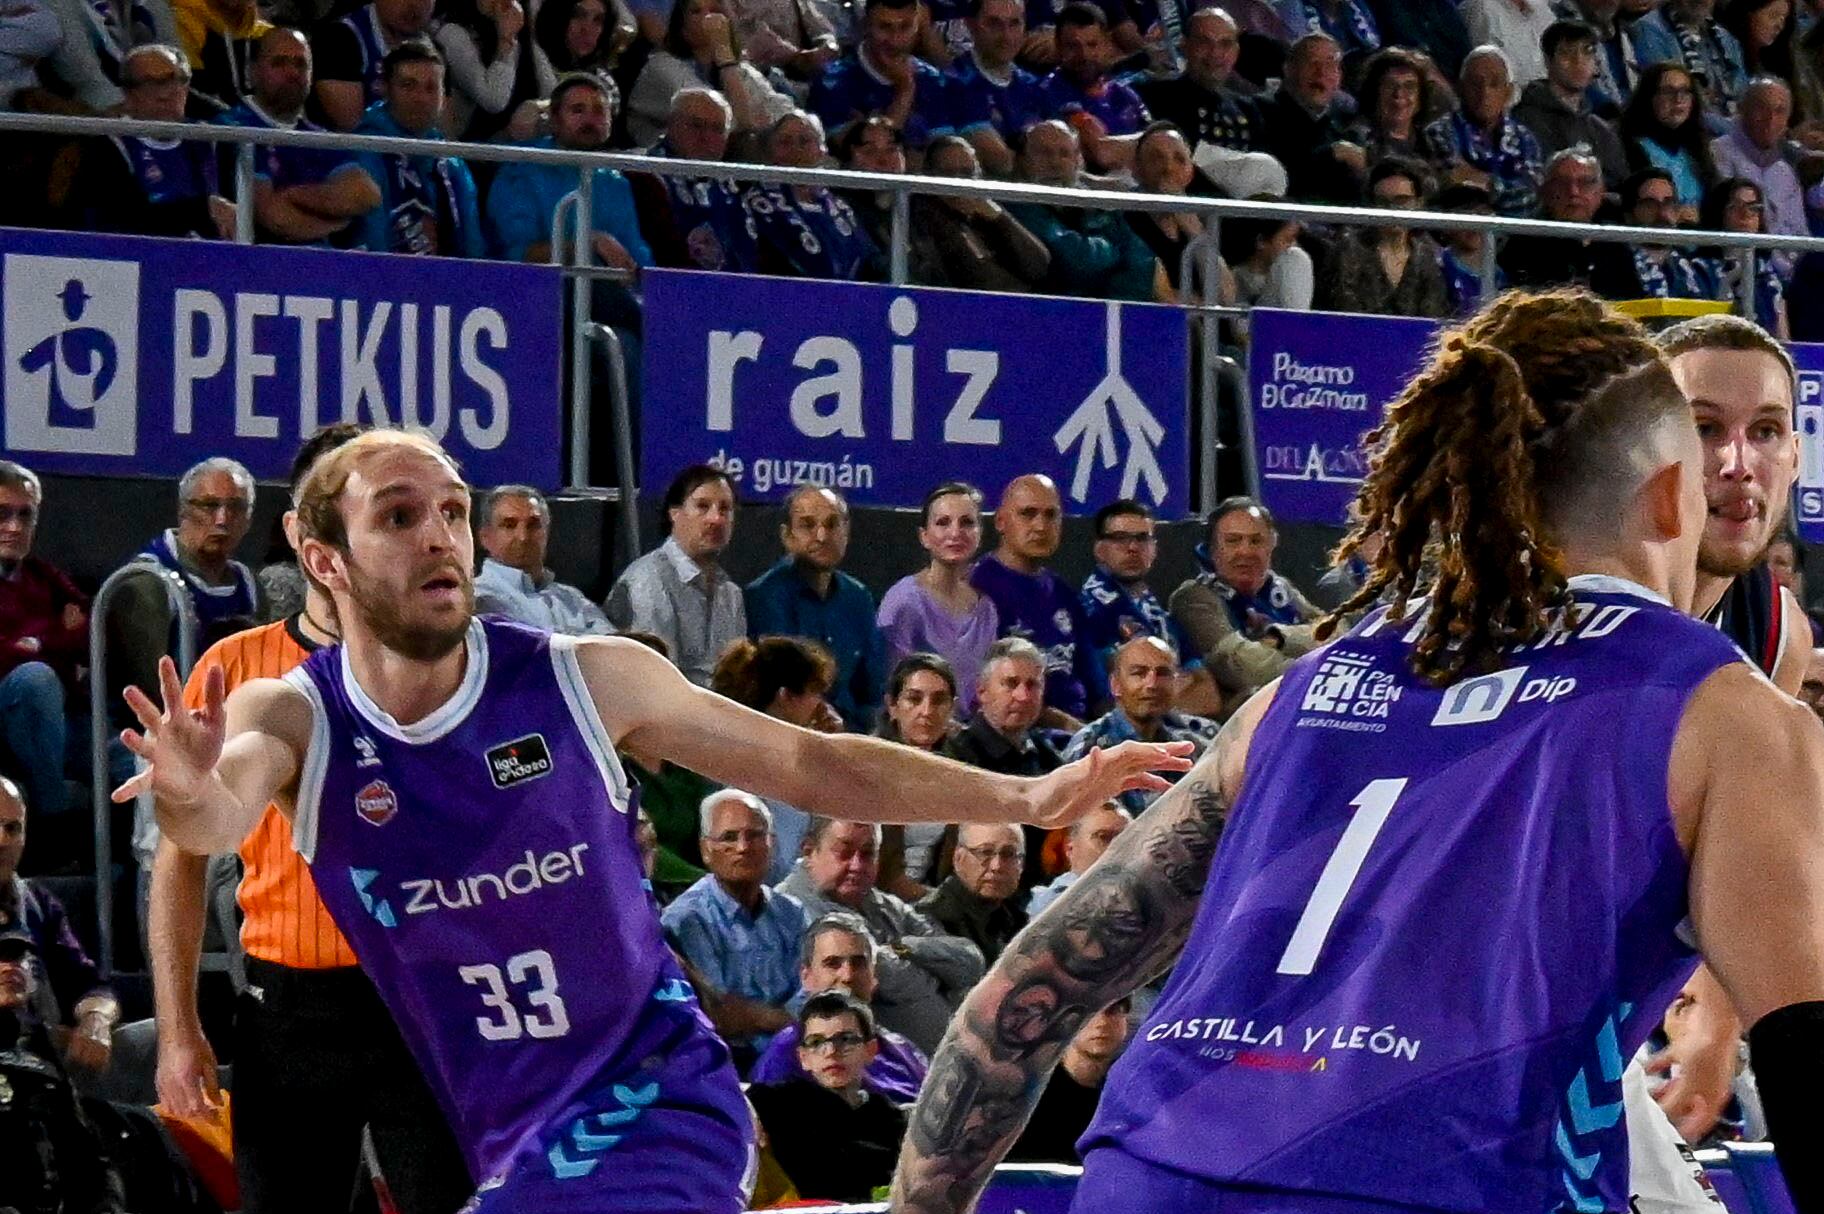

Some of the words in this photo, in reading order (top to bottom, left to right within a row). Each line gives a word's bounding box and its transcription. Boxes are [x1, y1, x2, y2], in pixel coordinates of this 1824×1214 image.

[172, 287, 511, 451] PETKUS
[705, 296, 1002, 445] raiz
[708, 448, 743, 483] de
[752, 453, 873, 492] guzmán
[400, 842, 590, 915] zunder
[1276, 777, 1409, 976] 1
[457, 949, 571, 1041] 33
[1146, 1017, 1284, 1048] CASTILLA
[1301, 1027, 1327, 1053] Y
[1331, 1023, 1422, 1062] LEÓN
